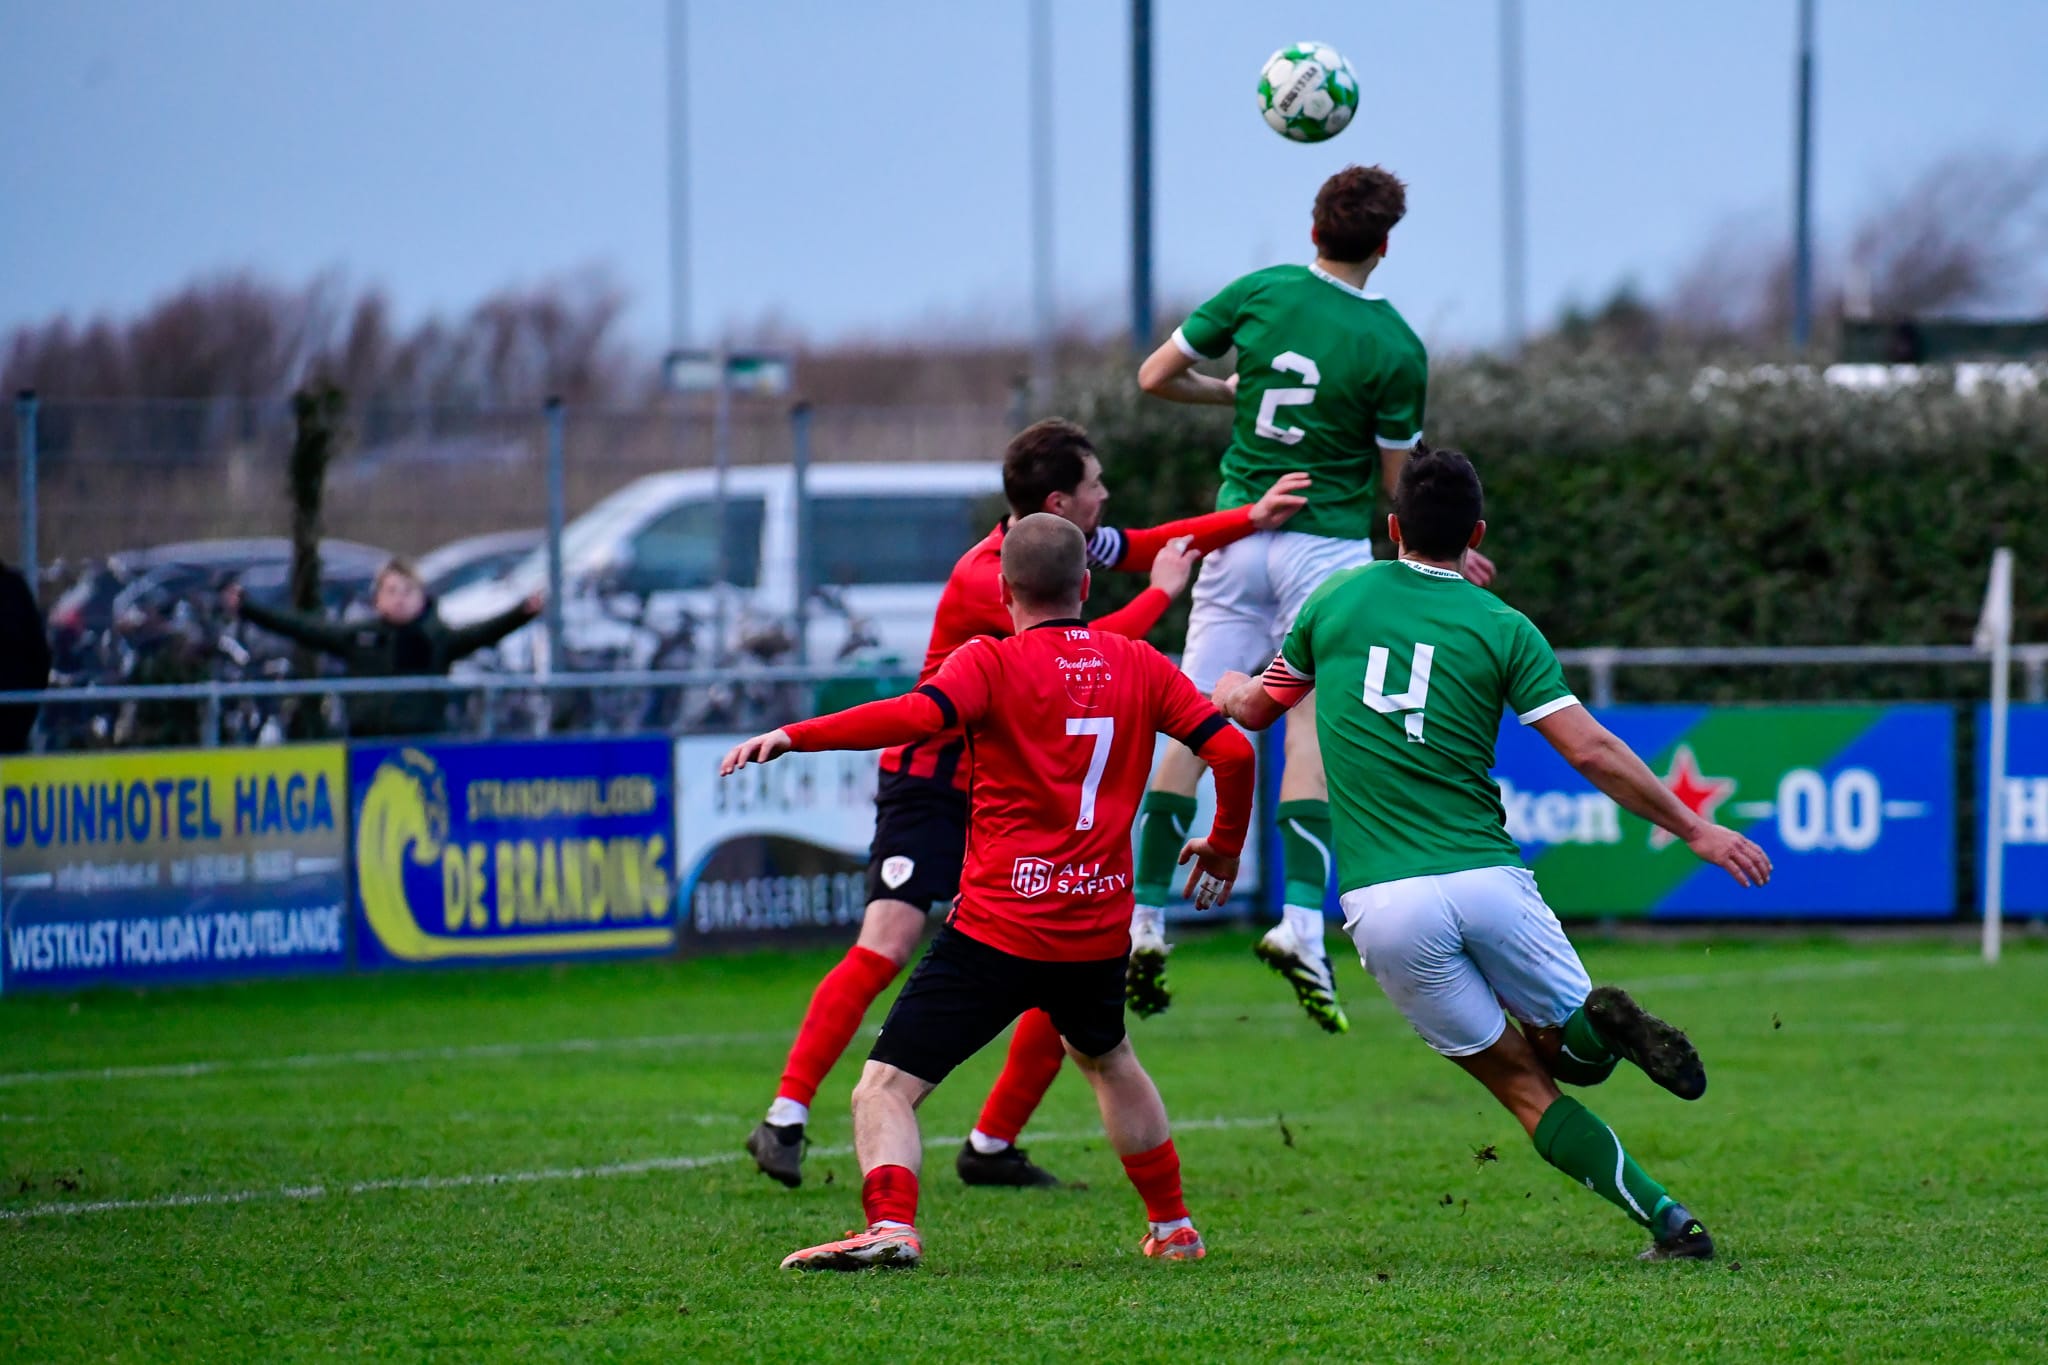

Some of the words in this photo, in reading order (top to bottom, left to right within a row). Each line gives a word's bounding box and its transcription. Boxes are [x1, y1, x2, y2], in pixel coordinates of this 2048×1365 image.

[1255, 350, 1321, 445] 2
[1064, 629, 1090, 641] 1920
[1363, 642, 1435, 744] 4
[4, 777, 222, 848] DUINHOTEL
[234, 771, 335, 837] HAGA
[1065, 716, 1114, 831] 7
[443, 842, 488, 930] DE
[496, 834, 668, 925] BRANDING
[9, 919, 118, 971] WESTKUST
[120, 912, 212, 964] HOLIDAY
[213, 904, 344, 959] ZOUTELANDE
